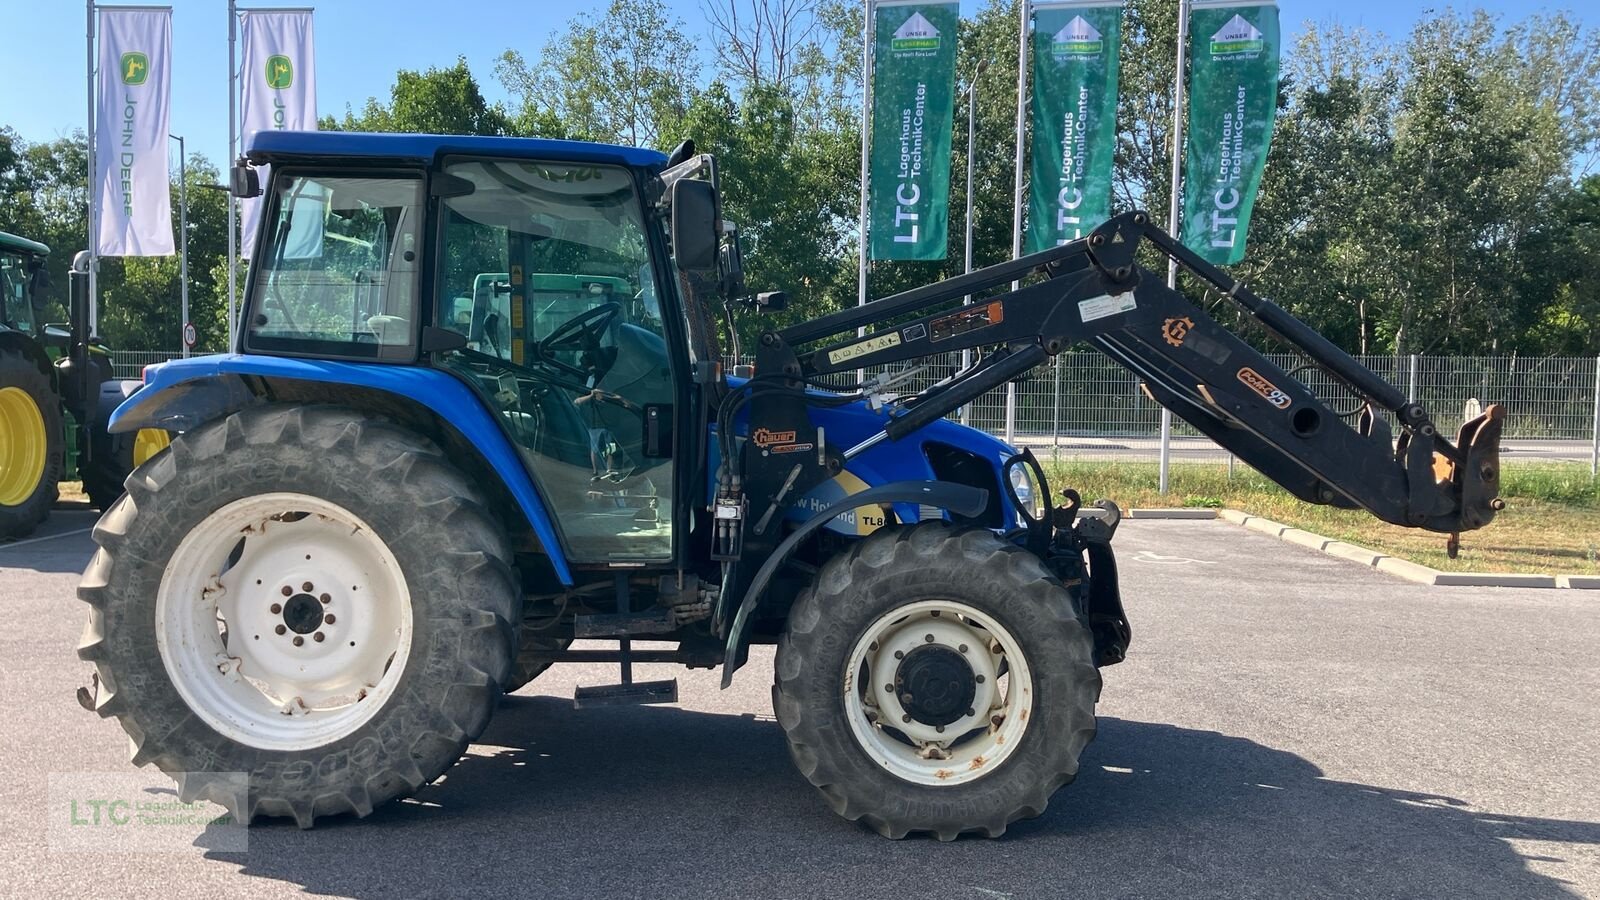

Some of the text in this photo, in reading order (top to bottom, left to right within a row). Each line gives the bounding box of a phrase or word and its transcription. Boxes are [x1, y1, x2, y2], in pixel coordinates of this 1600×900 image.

[120, 93, 138, 217] JOHN DEERE
[897, 108, 911, 178] Lagerhaus
[911, 82, 926, 178] TechnikCenter
[1059, 111, 1074, 182] Lagerhaus
[1072, 86, 1088, 183] TechnikCenter
[1217, 112, 1232, 182] Lagerhaus
[1229, 85, 1246, 182] TechnikCenter
[893, 183, 921, 243] LTC
[1056, 186, 1082, 246] LTC
[1211, 187, 1240, 248] LTC
[186, 328, 195, 341] 70
[1270, 389, 1287, 406] 95
[759, 432, 793, 443] hauer
[862, 516, 884, 527] TL8
